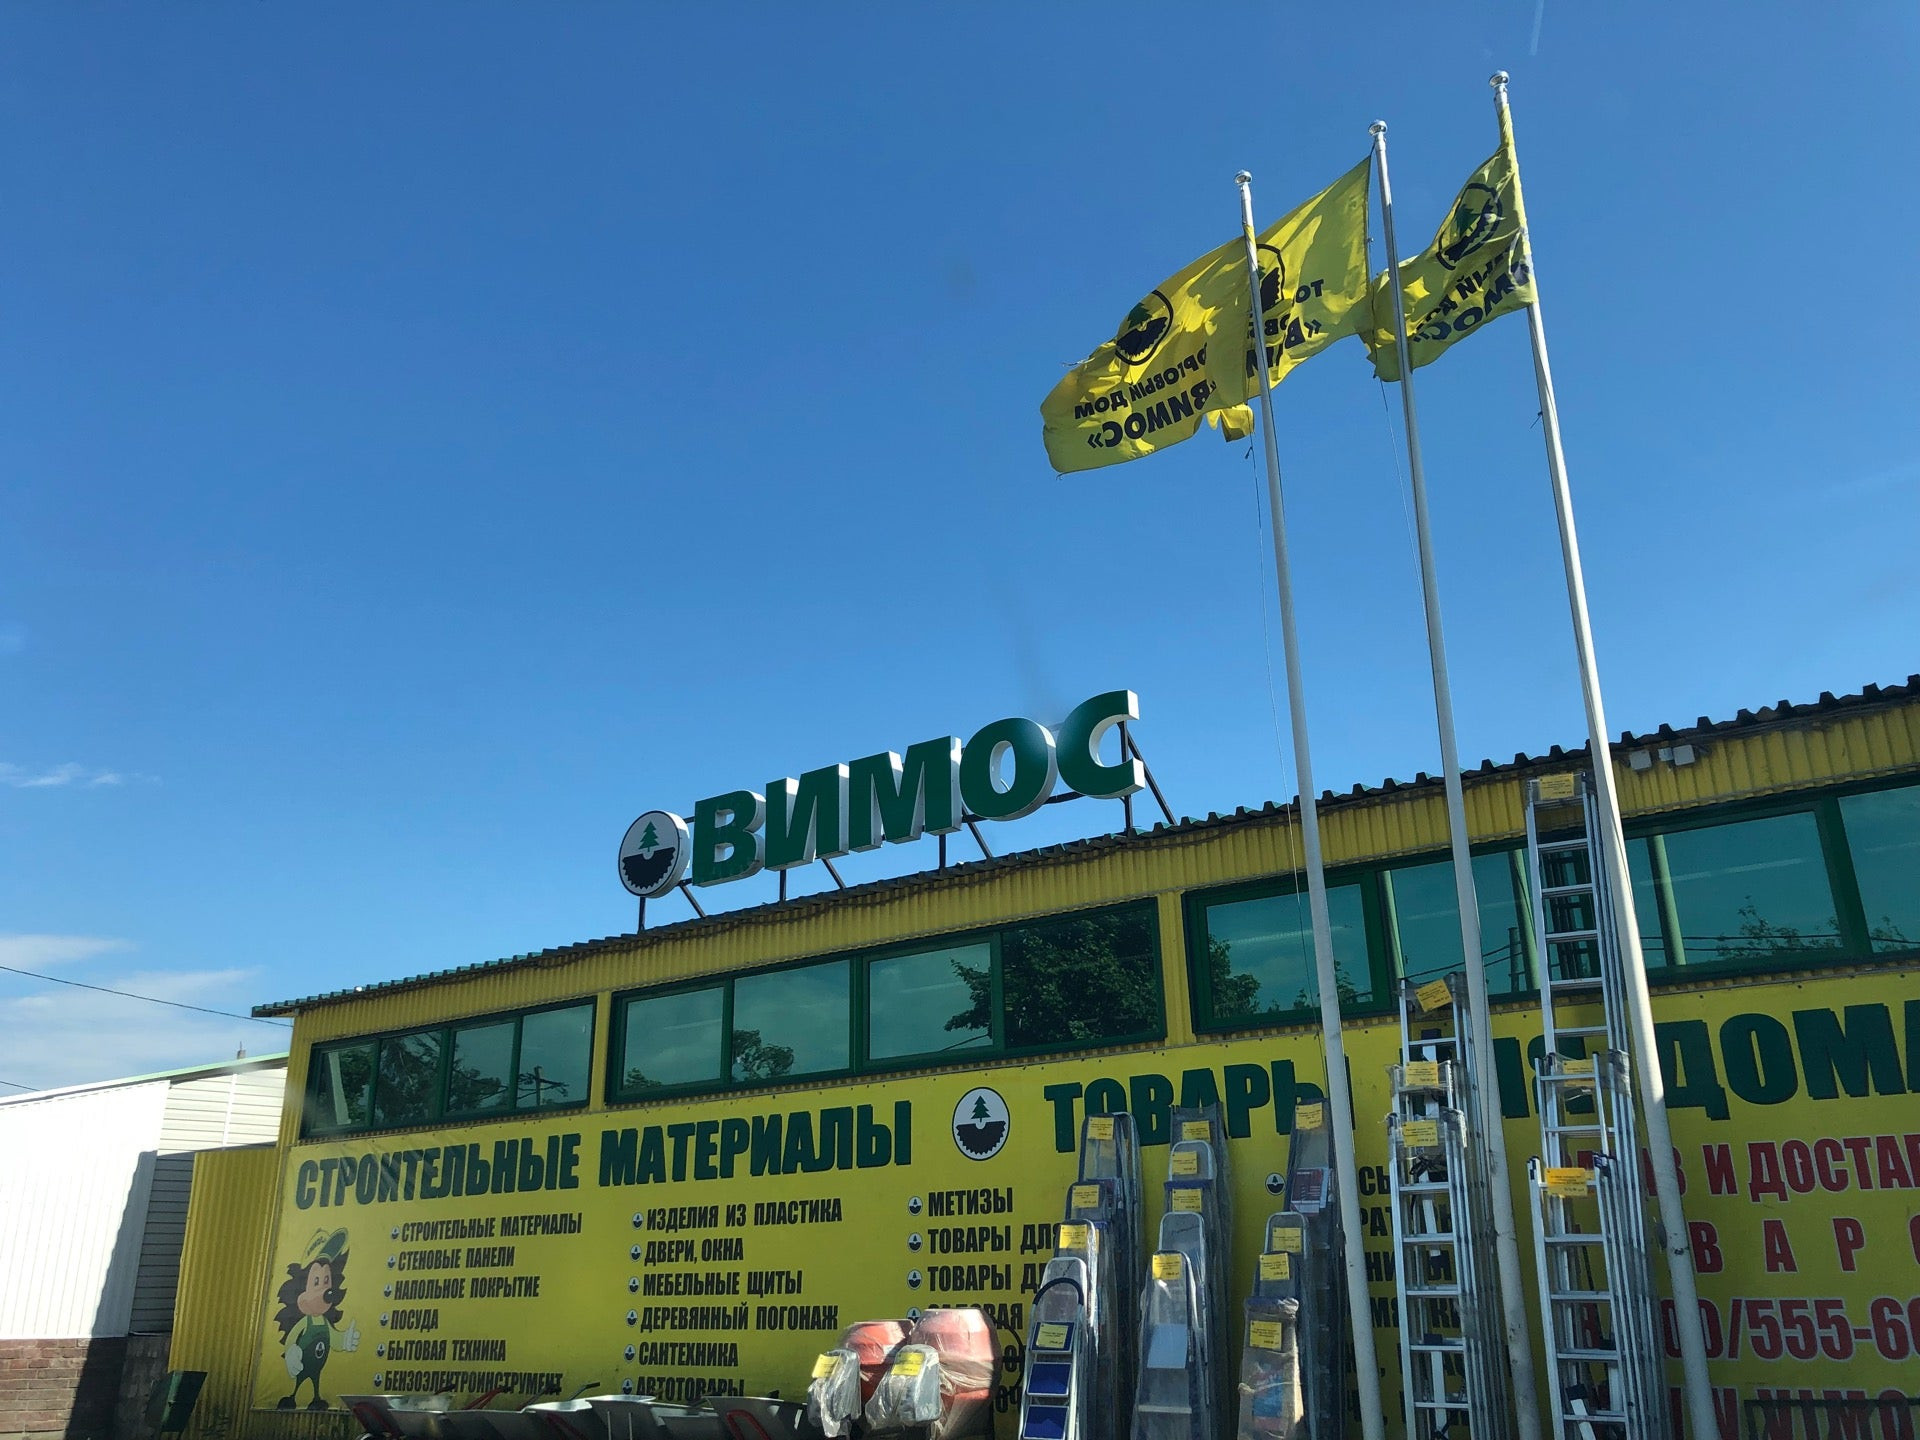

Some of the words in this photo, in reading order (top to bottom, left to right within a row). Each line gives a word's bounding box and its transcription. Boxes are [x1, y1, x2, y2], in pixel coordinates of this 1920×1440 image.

[692, 690, 1145, 887] ВИМОС
[295, 1133, 581, 1210] СТРОИТЕЛЬНЫЕ
[599, 1100, 912, 1187] МАТЕРИАЛЫ
[1654, 1000, 1920, 1121] ДОМ
[1703, 1143, 1738, 1195] И
[646, 1204, 719, 1233] ИЗДЕЛИЯ
[725, 1203, 747, 1227] ИЗ
[754, 1198, 843, 1226] ПЛАСТИКА
[928, 1187, 1013, 1217] МЕТИЗЫ
[401, 1218, 495, 1242] СТРОИТЕЛЬНЫЕ
[500, 1212, 583, 1236] МАТЕРИАЛЫ
[928, 1225, 1011, 1254] ТОВАРЫ
[397, 1249, 461, 1271] СТЕНОВЫЕ
[465, 1246, 515, 1268] ПАНЕЛИ
[644, 1240, 698, 1266] ДВЕРИ,
[701, 1238, 744, 1261] ОКНА
[394, 1278, 465, 1301] НАПОЛЬНОЕ
[470, 1276, 540, 1299] ПОКРЫТИЕ
[643, 1272, 740, 1297] МЕБЕЛЬНЫЕ
[747, 1270, 803, 1298] ЩИТЫ
[928, 1264, 1011, 1292] ТОВАРЫ
[390, 1309, 439, 1331] ПОСУДА
[640, 1302, 749, 1333] ДЕРЕВЯННЫЙ
[756, 1305, 839, 1331] ПОГОНАЖ
[387, 1340, 447, 1362] БЫТОВАЯ
[452, 1340, 506, 1362] ТЕХНИКА
[638, 1341, 739, 1367] САНТЕХНИКА
[384, 1370, 563, 1396] БЕНЗОЭЛЕКТРОИНСТРУМЕНТ
[636, 1376, 745, 1401] АВТОТОВАРЫ
